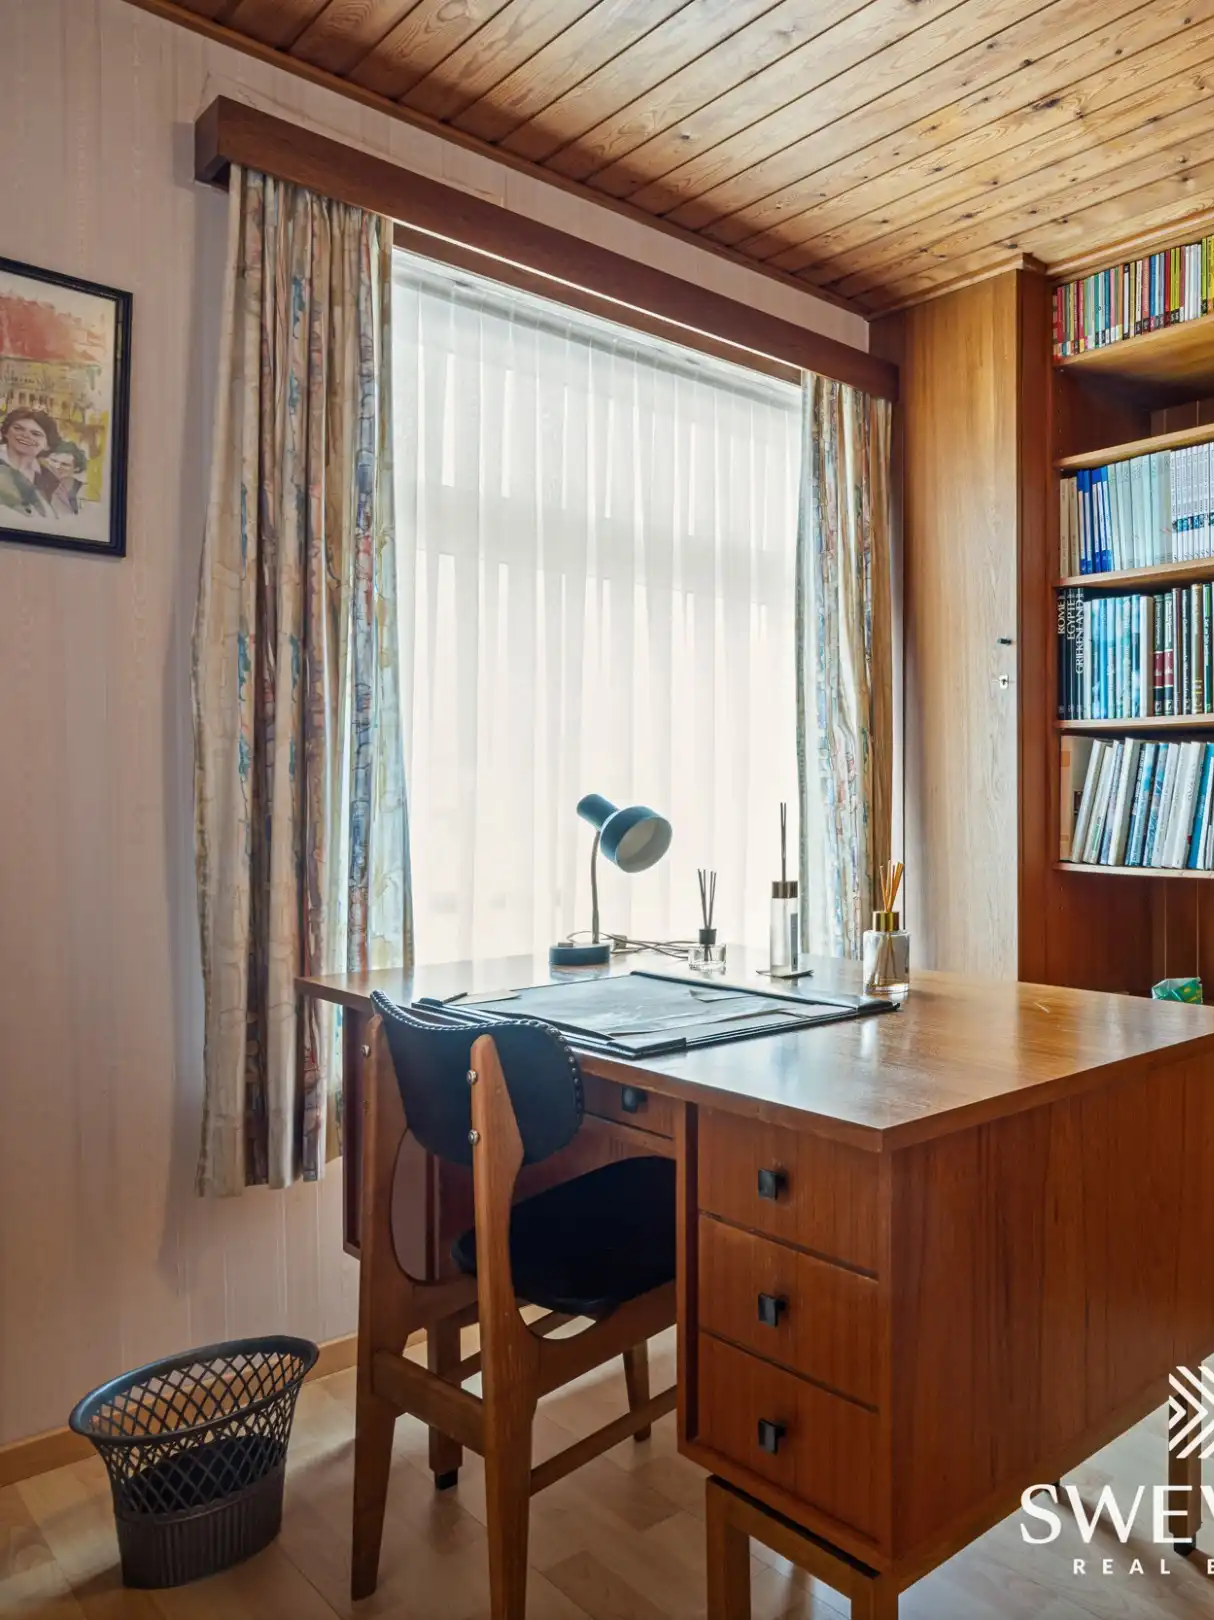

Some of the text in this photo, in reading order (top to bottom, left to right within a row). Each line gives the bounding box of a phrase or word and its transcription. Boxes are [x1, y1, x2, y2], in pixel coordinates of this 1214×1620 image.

[1057, 600, 1065, 634] ROME
[1067, 600, 1075, 640] EGYPTE
[1076, 599, 1084, 673] GRIEKENLAND
